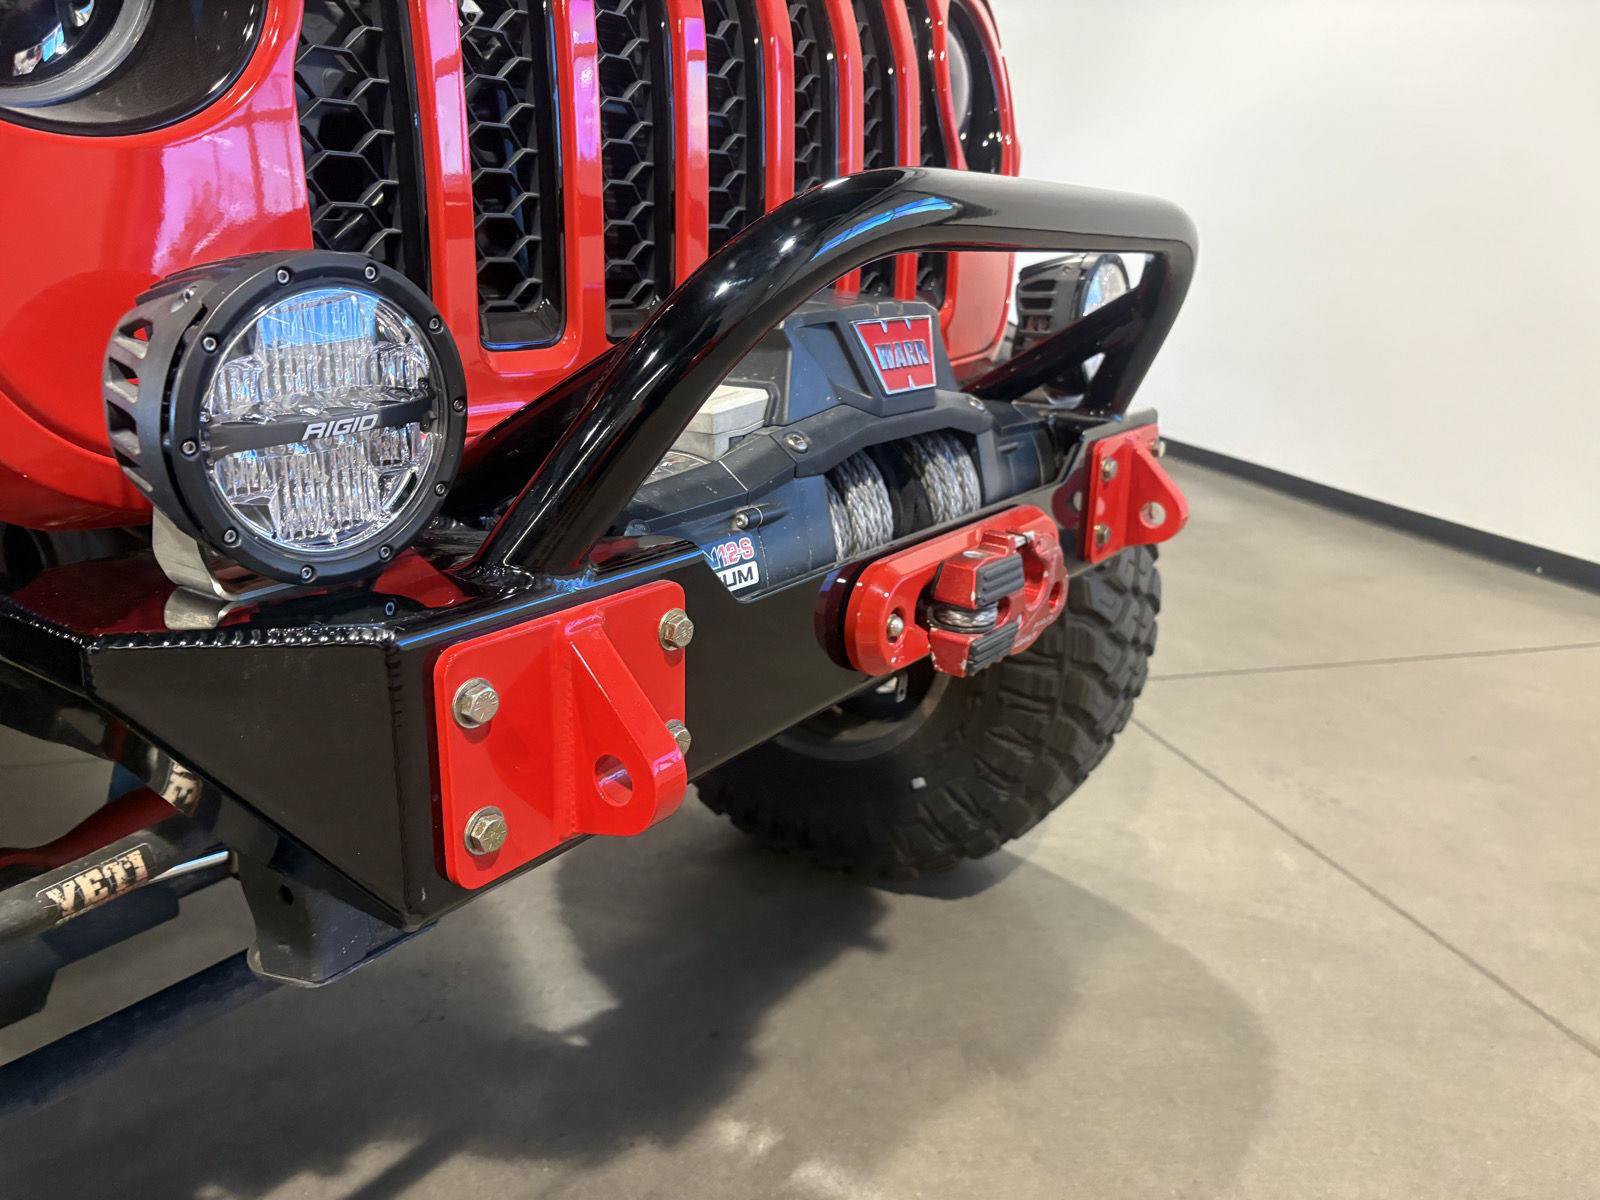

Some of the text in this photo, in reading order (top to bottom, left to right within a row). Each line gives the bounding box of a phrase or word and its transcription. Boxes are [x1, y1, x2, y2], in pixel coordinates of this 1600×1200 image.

[874, 340, 930, 370] WARN
[301, 413, 379, 441] RIGID
[45, 849, 149, 917] YETI
